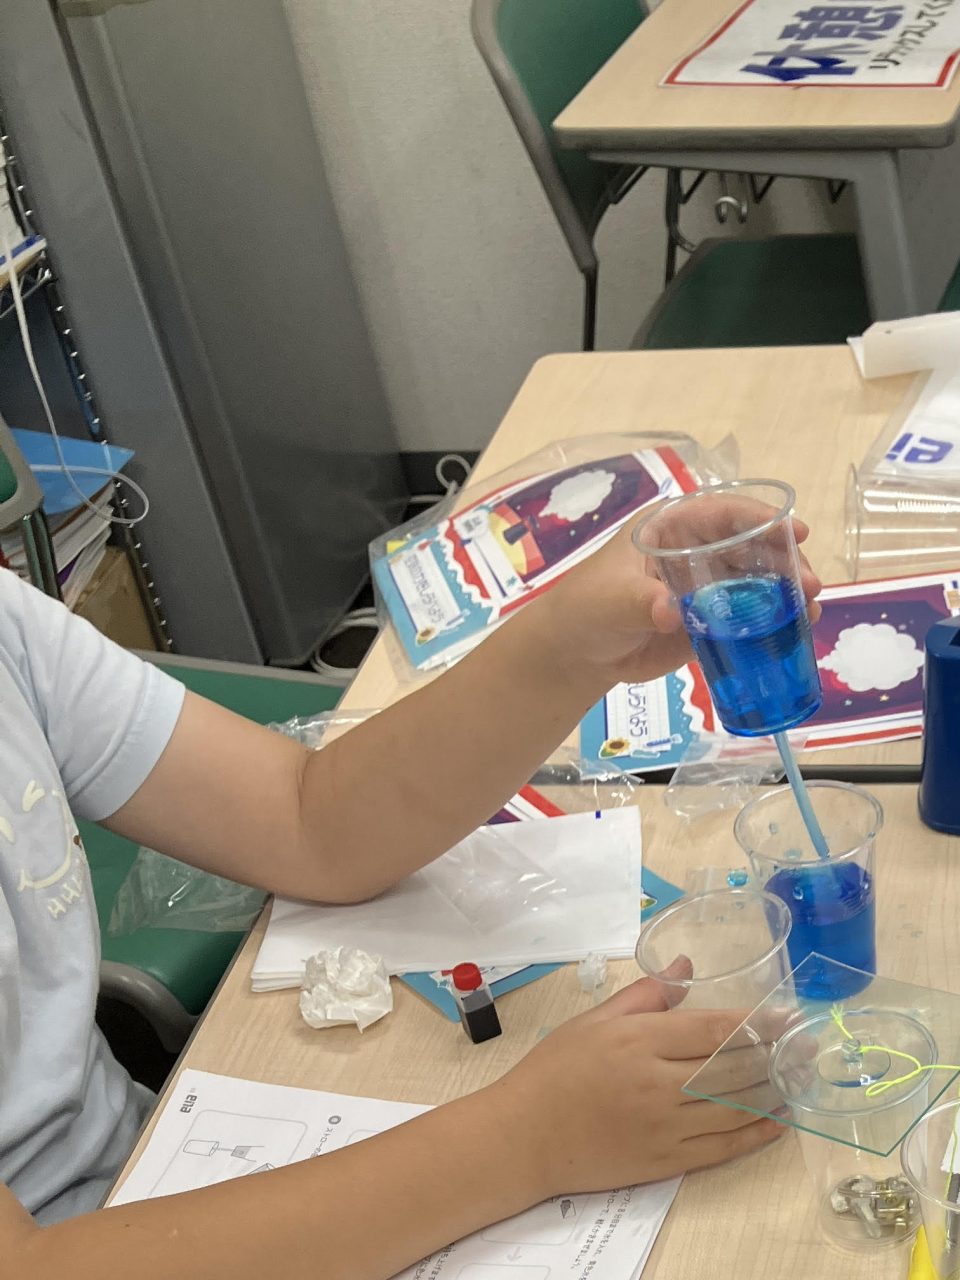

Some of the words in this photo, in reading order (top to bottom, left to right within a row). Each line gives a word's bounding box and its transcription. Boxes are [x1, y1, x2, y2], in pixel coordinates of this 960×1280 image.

[740, 5, 906, 82] 休憩
[868, 0, 951, 70] リラックスしてく
[180, 1094, 198, 1114] ena
